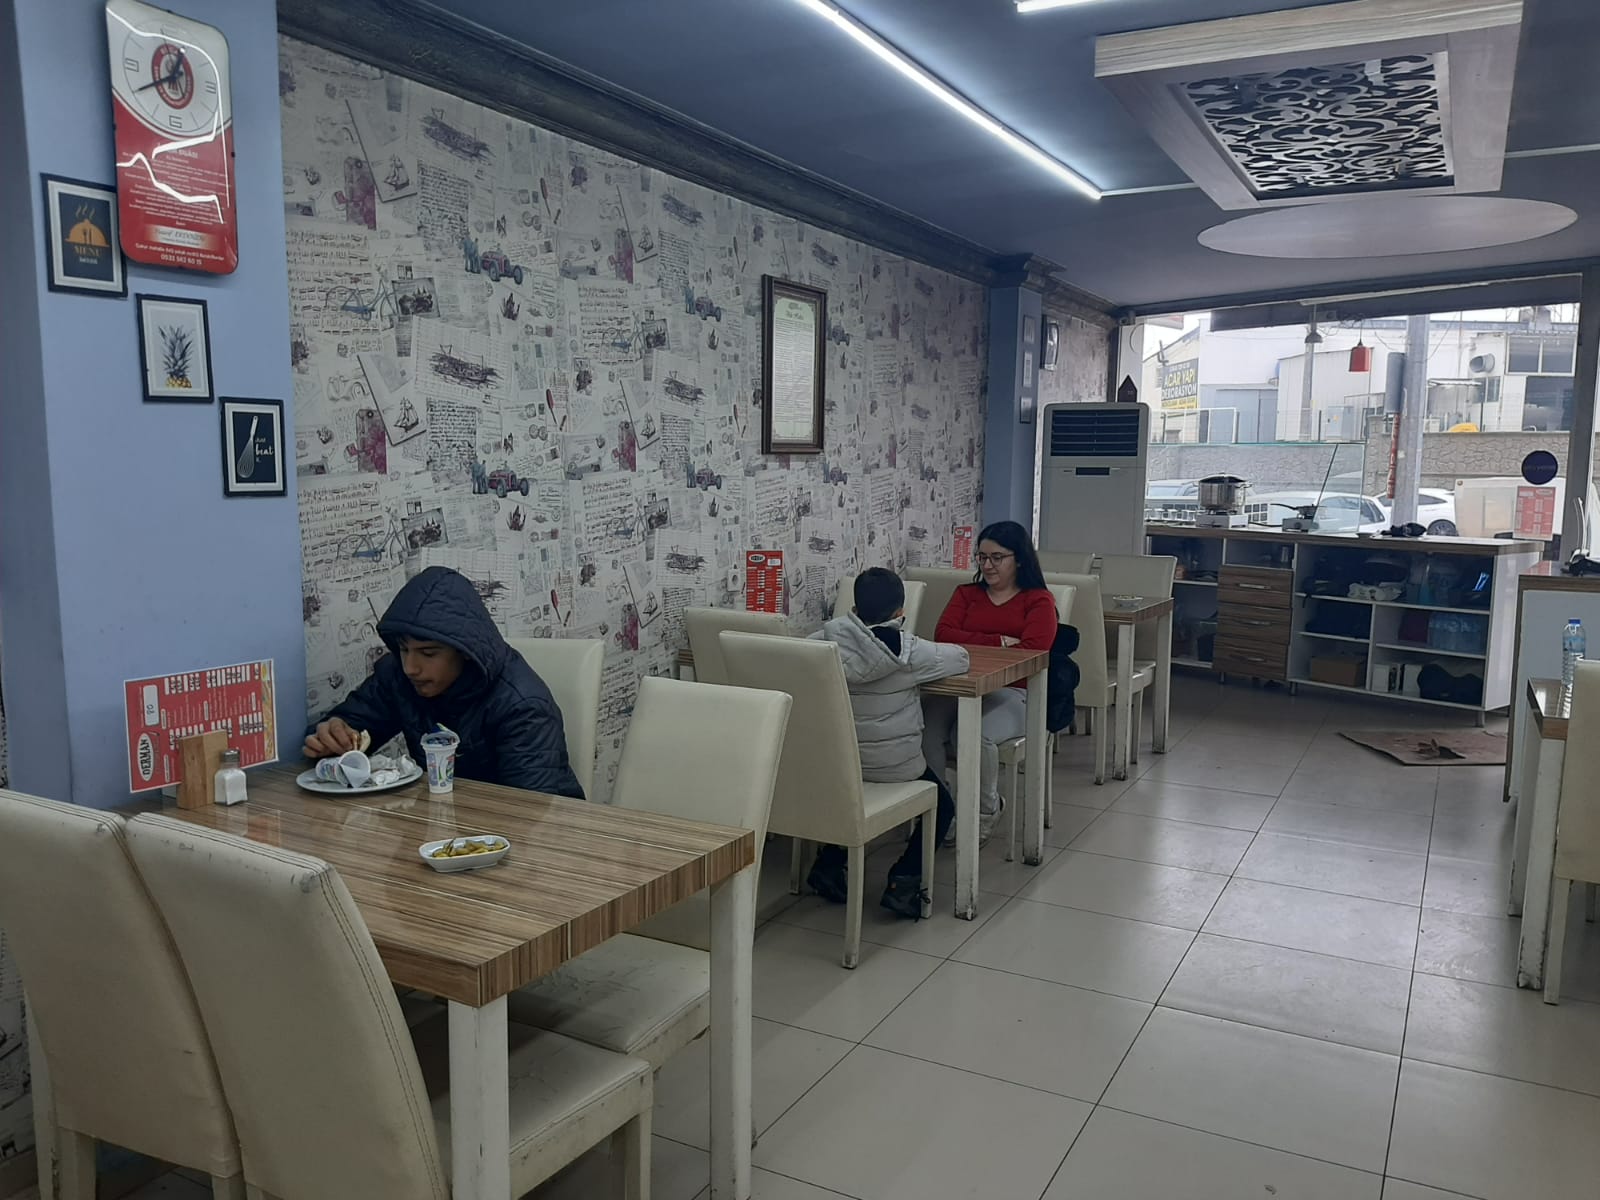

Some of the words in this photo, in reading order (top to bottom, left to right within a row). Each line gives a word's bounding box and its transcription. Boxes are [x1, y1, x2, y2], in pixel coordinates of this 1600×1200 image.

[1161, 383, 1197, 400] DEKORASYON
[255, 443, 274, 456] beat
[140, 738, 151, 775] DERMAN
